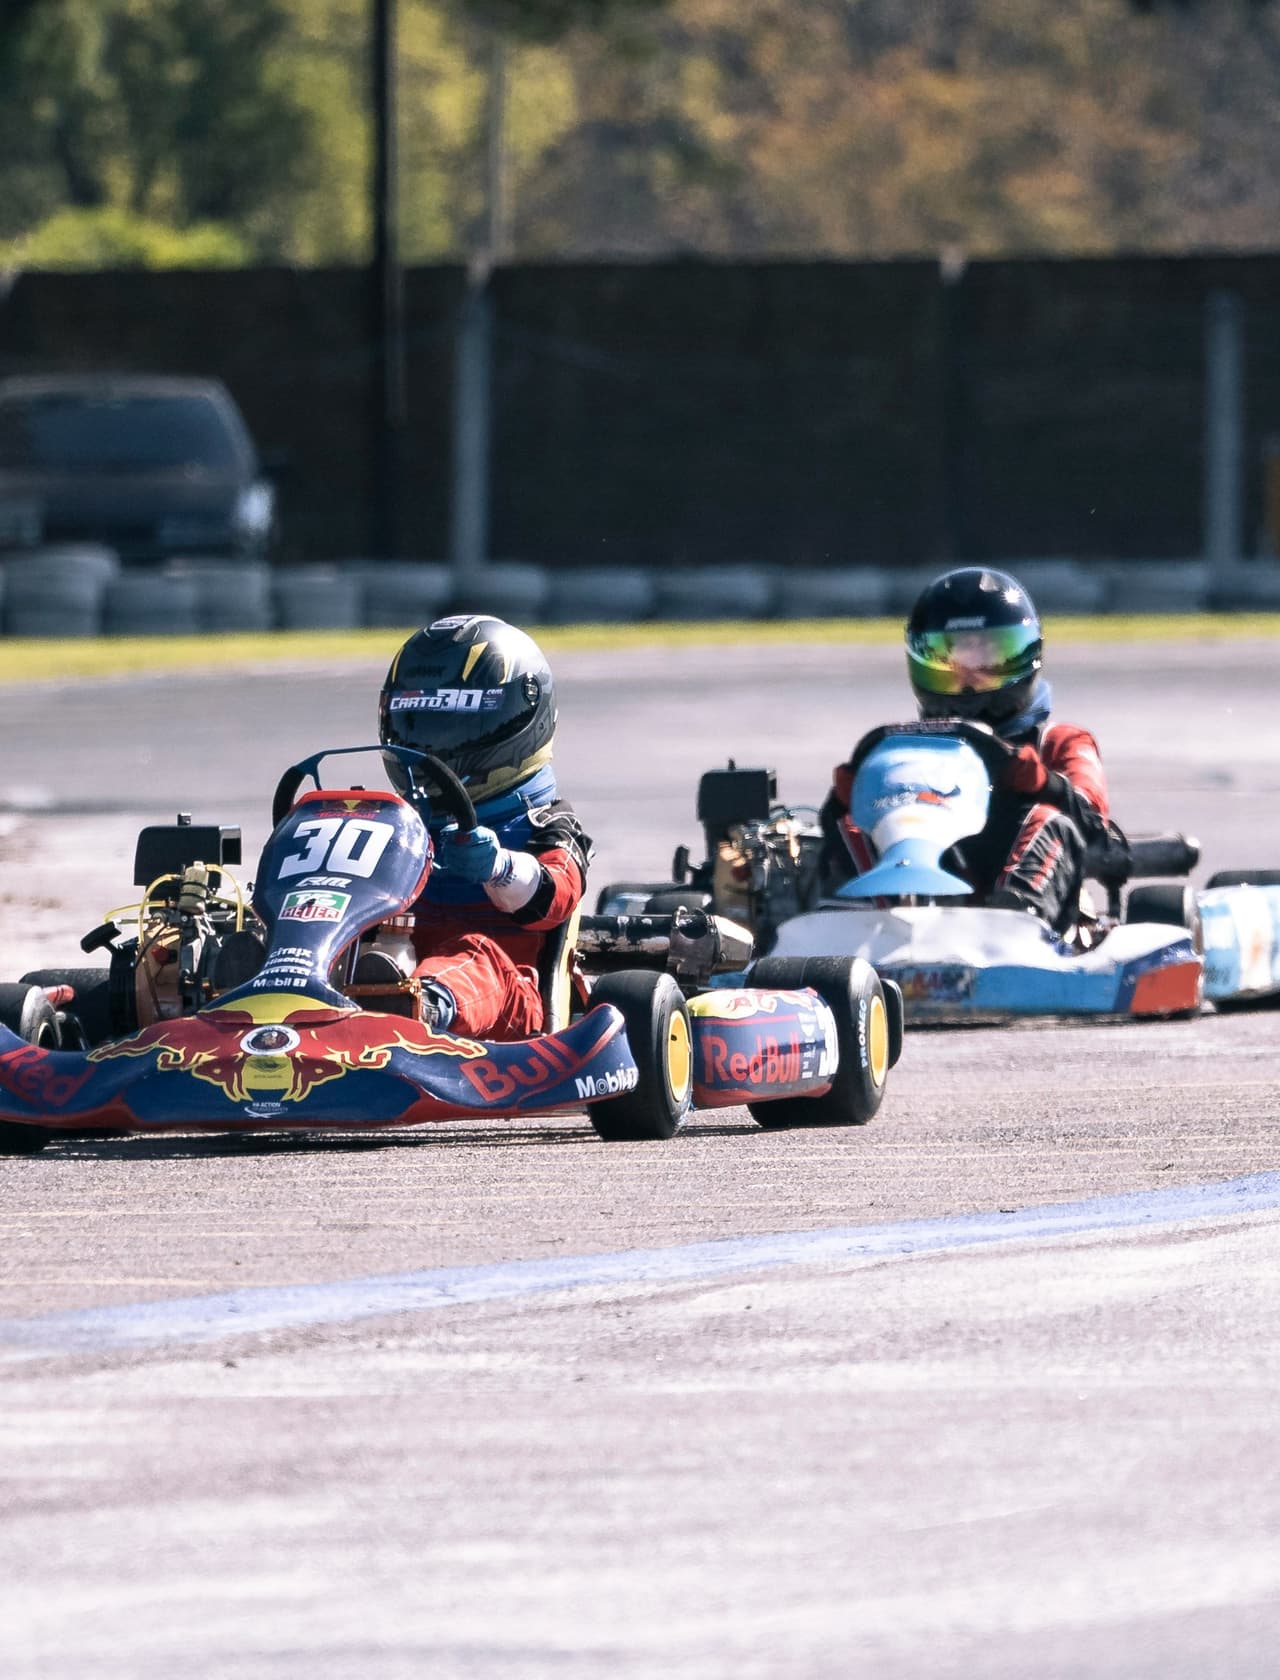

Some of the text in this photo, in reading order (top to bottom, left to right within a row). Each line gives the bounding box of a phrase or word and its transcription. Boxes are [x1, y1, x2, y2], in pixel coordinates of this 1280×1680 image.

[278, 818, 395, 880] 30
[282, 906, 339, 919] HEUER
[253, 977, 292, 988] Mobil
[459, 1035, 582, 1104] Bull
[701, 1034, 763, 1083] Red
[766, 1032, 801, 1083] Bull
[575, 1068, 626, 1098] Mobil
